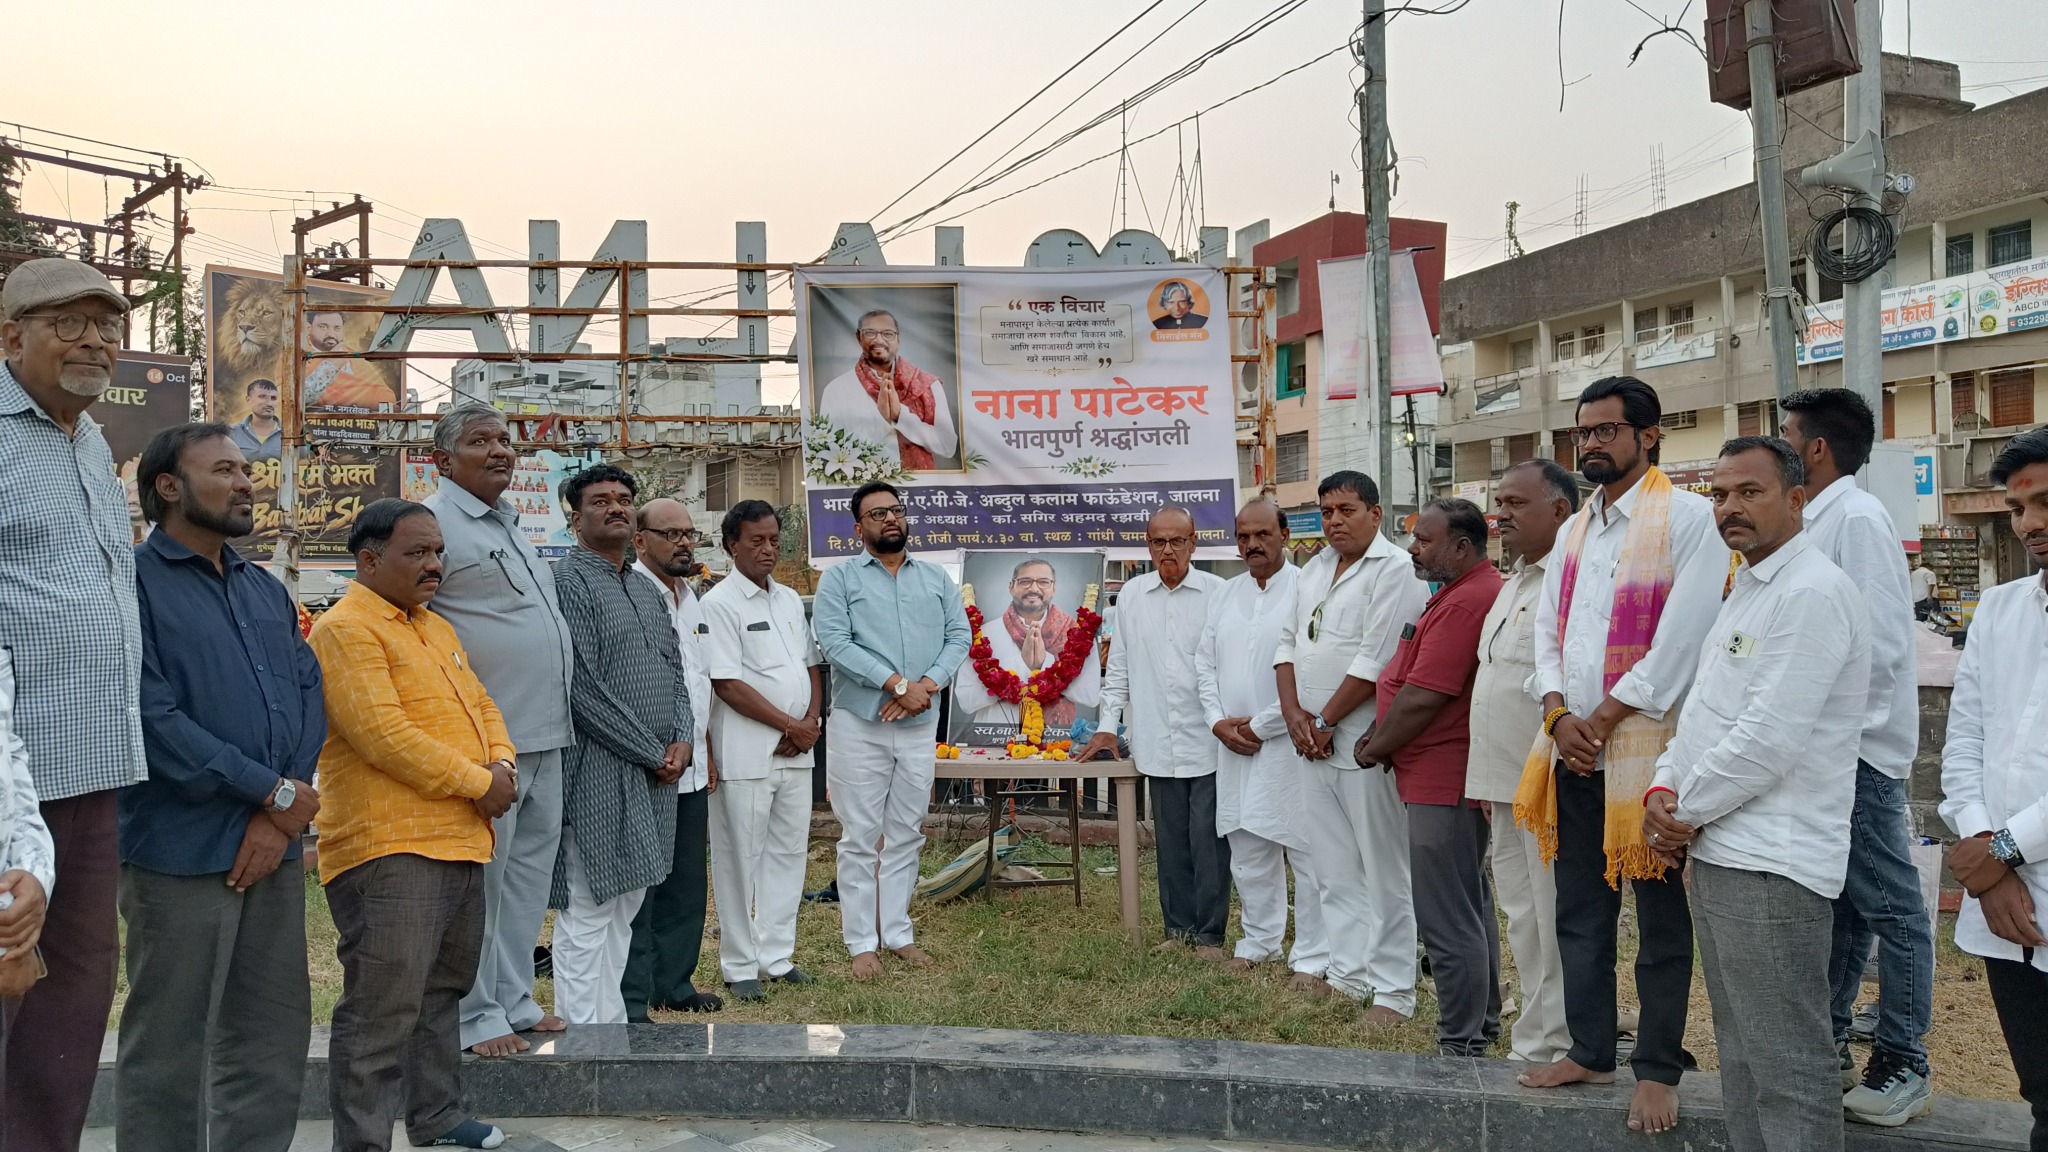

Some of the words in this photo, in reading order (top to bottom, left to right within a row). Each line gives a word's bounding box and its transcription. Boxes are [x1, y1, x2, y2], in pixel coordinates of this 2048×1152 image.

[1028, 300, 1055, 315] एक
[1060, 296, 1106, 314] विचार
[2014, 301, 2040, 313] ABCD
[149, 372, 162, 380] 14
[166, 373, 186, 383] Oct
[971, 389, 1061, 420] नाना
[1071, 377, 1209, 418] पाटेकर
[1001, 421, 1083, 458] भावपुर्ण
[1089, 418, 1190, 450] श्रद्धांजली
[331, 464, 376, 486] भक्त
[979, 494, 1025, 513] अब्दुल
[1029, 493, 1078, 505] कलाम
[1169, 489, 1221, 503] जालना
[923, 514, 968, 526] अध्यक्ष
[992, 514, 1017, 525] का.
[1020, 509, 1056, 524] सगिर
[1061, 512, 1106, 524] अहमद
[926, 531, 952, 544] रोजी
[1019, 532, 1039, 543] वा.
[1044, 530, 1071, 542] स्थळ
[1087, 527, 1115, 542] गांधी
